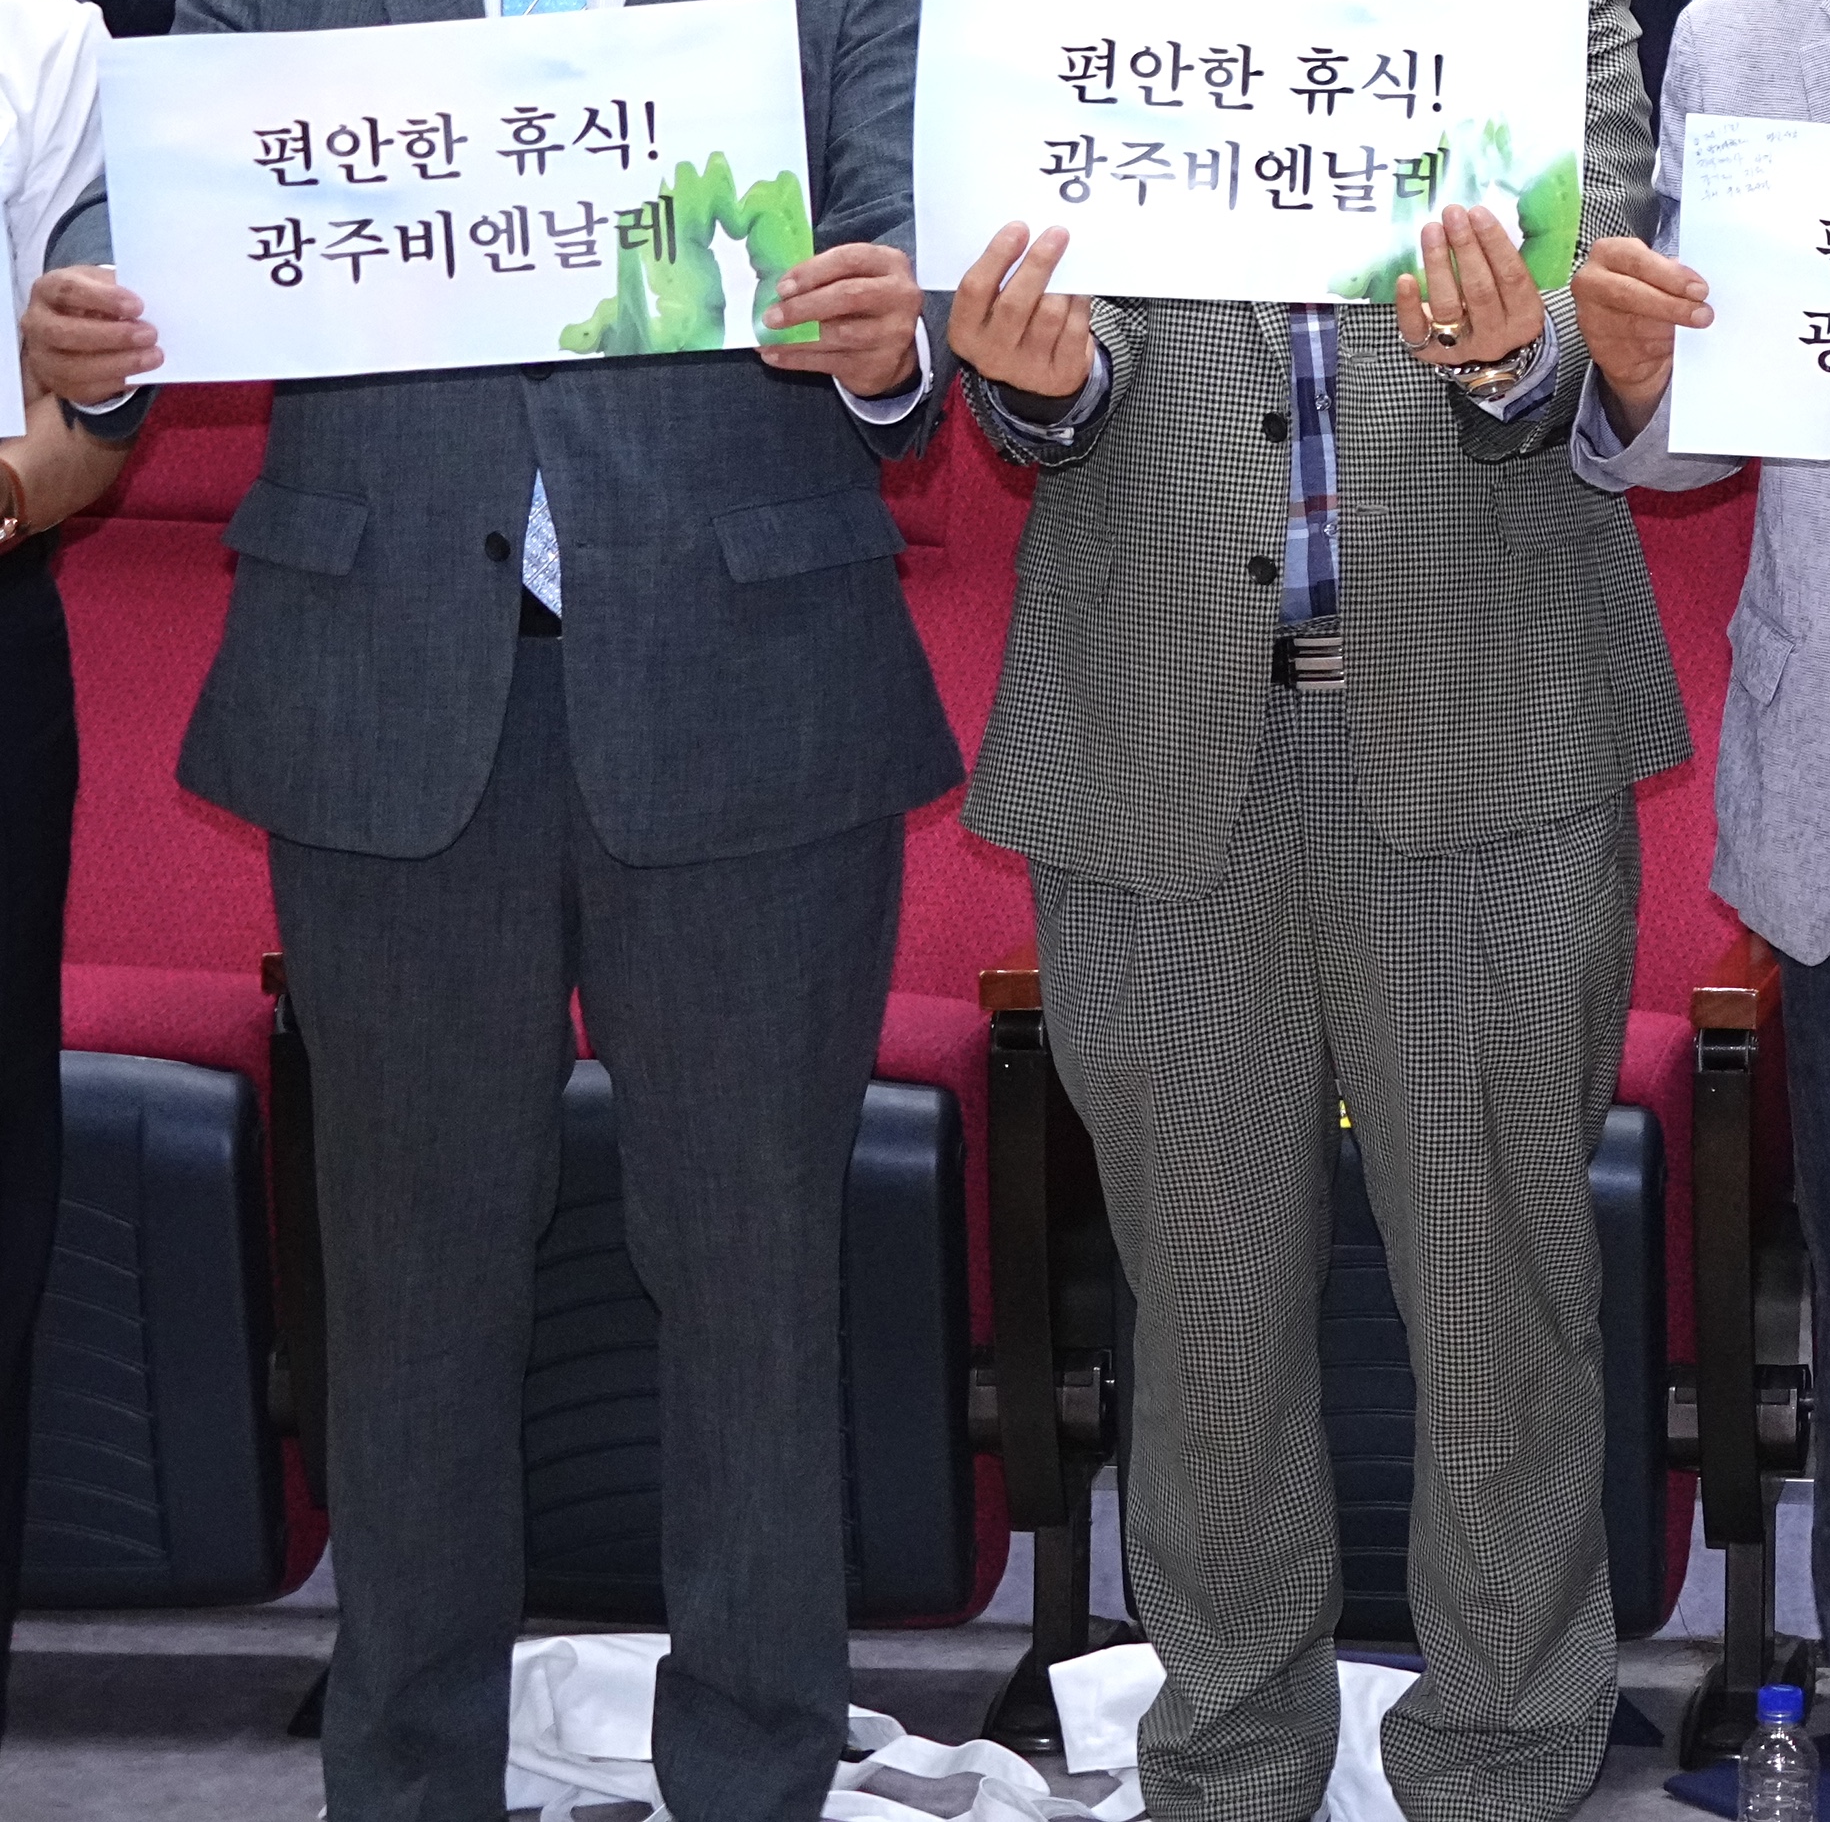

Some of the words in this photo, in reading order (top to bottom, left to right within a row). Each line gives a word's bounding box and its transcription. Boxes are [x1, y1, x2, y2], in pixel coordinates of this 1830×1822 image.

[1058, 37, 1265, 111] 편안한
[1289, 44, 1446, 120] 휴식!
[252, 110, 469, 189] 편안한
[496, 98, 662, 178] 휴식!
[1038, 133, 1451, 214] 광주비엔날레
[246, 193, 679, 288] 광주비엔날레
